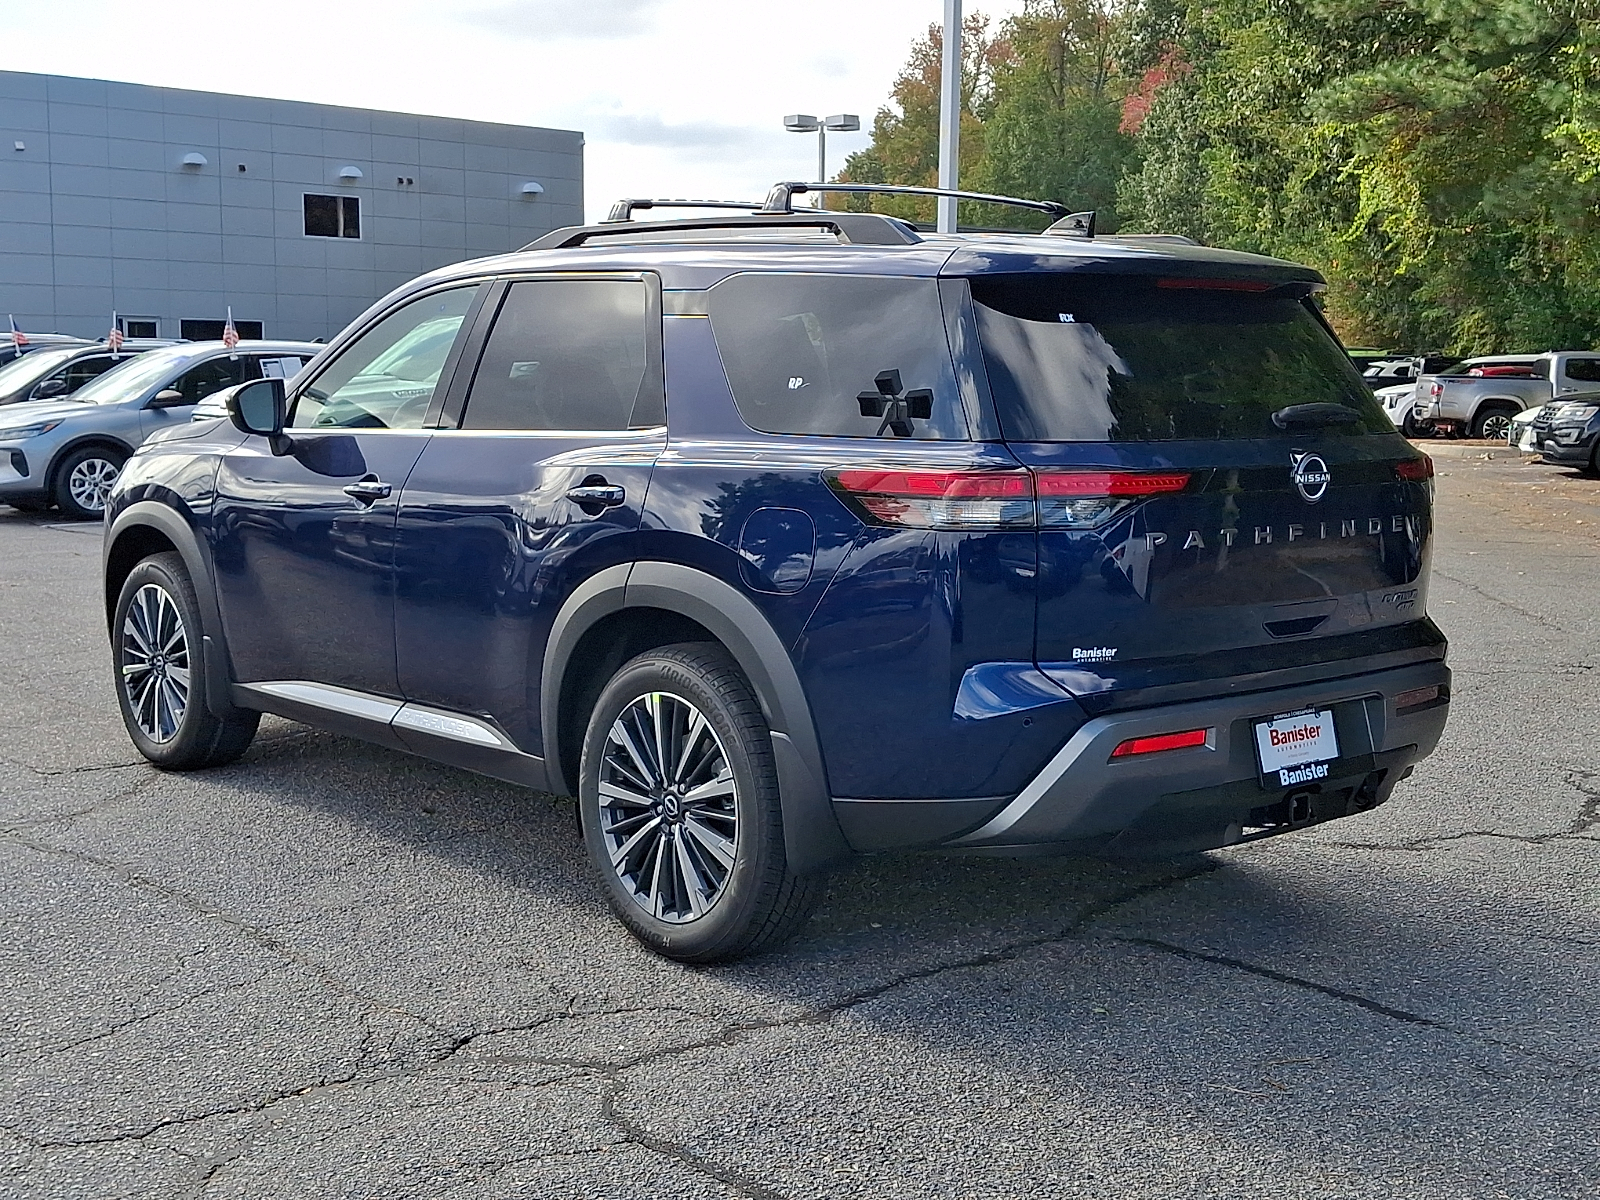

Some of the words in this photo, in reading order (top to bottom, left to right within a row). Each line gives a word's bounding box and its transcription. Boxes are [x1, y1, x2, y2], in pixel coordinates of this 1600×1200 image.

[1295, 473, 1331, 483] NISSAN
[1072, 646, 1118, 659] Banister
[1270, 724, 1321, 746] Banister
[1279, 763, 1329, 786] Banister
